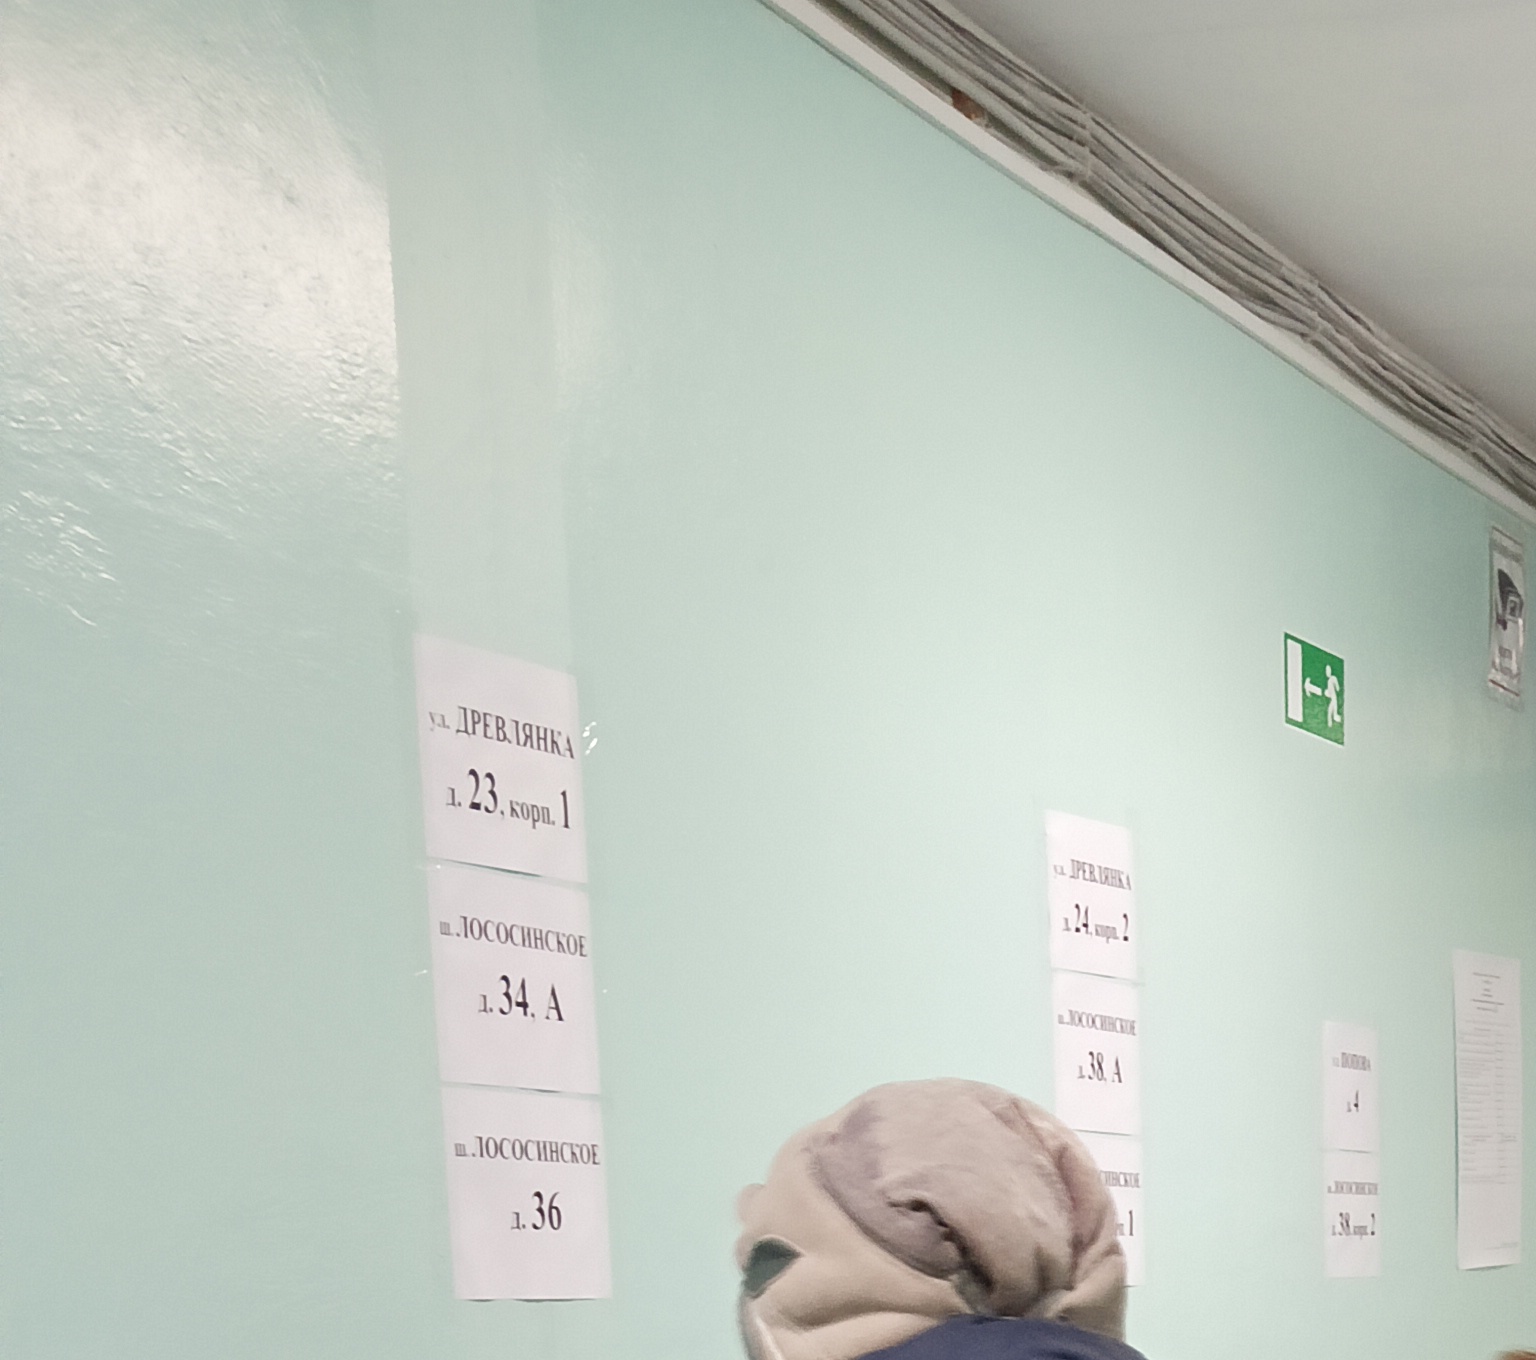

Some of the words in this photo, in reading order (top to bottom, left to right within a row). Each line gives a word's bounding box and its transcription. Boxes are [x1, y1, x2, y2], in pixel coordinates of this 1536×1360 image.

[456, 705, 576, 760] ДРЕВЛЯНКА
[509, 799, 556, 830] корп.
[560, 789, 571, 830] 1
[545, 983, 565, 1022] А
[1112, 1055, 1123, 1084] А
[531, 1190, 563, 1231] 36
